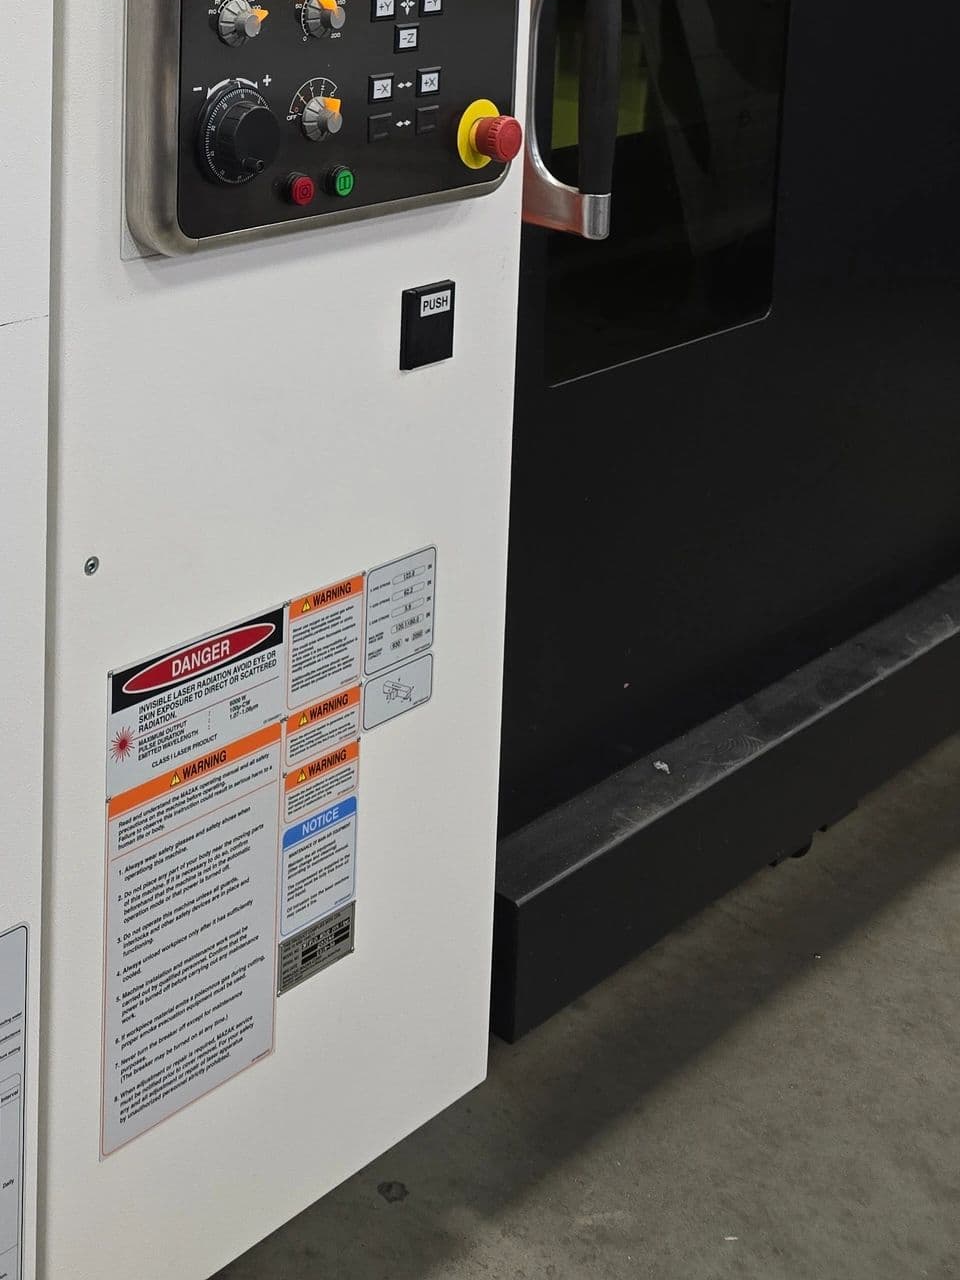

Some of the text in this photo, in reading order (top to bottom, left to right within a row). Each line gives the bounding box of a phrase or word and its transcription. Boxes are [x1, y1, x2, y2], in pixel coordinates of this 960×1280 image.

[379, 1, 392, 12] +Y
[424, 77, 436, 87] +X
[423, 296, 448, 312] PUSH
[312, 582, 352, 607] WARNING
[172, 639, 230, 678] DANGER
[139, 649, 275, 714] INVISIBLE LASER RADIATION AVOID EYE OR
[139, 658, 276, 724] SKIN EXPOSURE TO DIRECT OR SCATTERED
[309, 693, 349, 720] WARNING
[138, 720, 186, 747] MAXIMUM OUTPUT
[139, 710, 177, 734] RADIATION.
[138, 728, 184, 754] PULSE DURATION
[138, 728, 198, 761] EMITTED WAVELENGTH
[151, 755, 169, 768] CLASS
[173, 745, 191, 758] LASER
[192, 733, 216, 749] PRODUCT
[182, 750, 227, 780] WARNING
[307, 749, 347, 777] WARNING
[118, 816, 131, 827] Read
[132, 811, 141, 820] and
[143, 797, 170, 815] understand
[180, 785, 198, 798] MAZAK
[199, 775, 221, 789] operating
[222, 766, 238, 778] manual
[240, 761, 248, 770] and
[256, 753, 268, 762] safety
[118, 830, 135, 842] Failure
[143, 817, 162, 830] observe
[163, 812, 172, 820] this
[174, 800, 199, 816] instruction
[200, 792, 213, 803] could
[214, 785, 227, 796] result
[234, 775, 250, 787] serious
[251, 769, 262, 778] harm
[119, 816, 147, 835] precautions
[165, 799, 185, 812] machine
[186, 791, 201, 802] before
[202, 781, 225, 794] operating.
[302, 806, 340, 836] NOTICE
[1, 1088, 18, 1102] Interval
[2, 1178, 15, 1189] Daily
